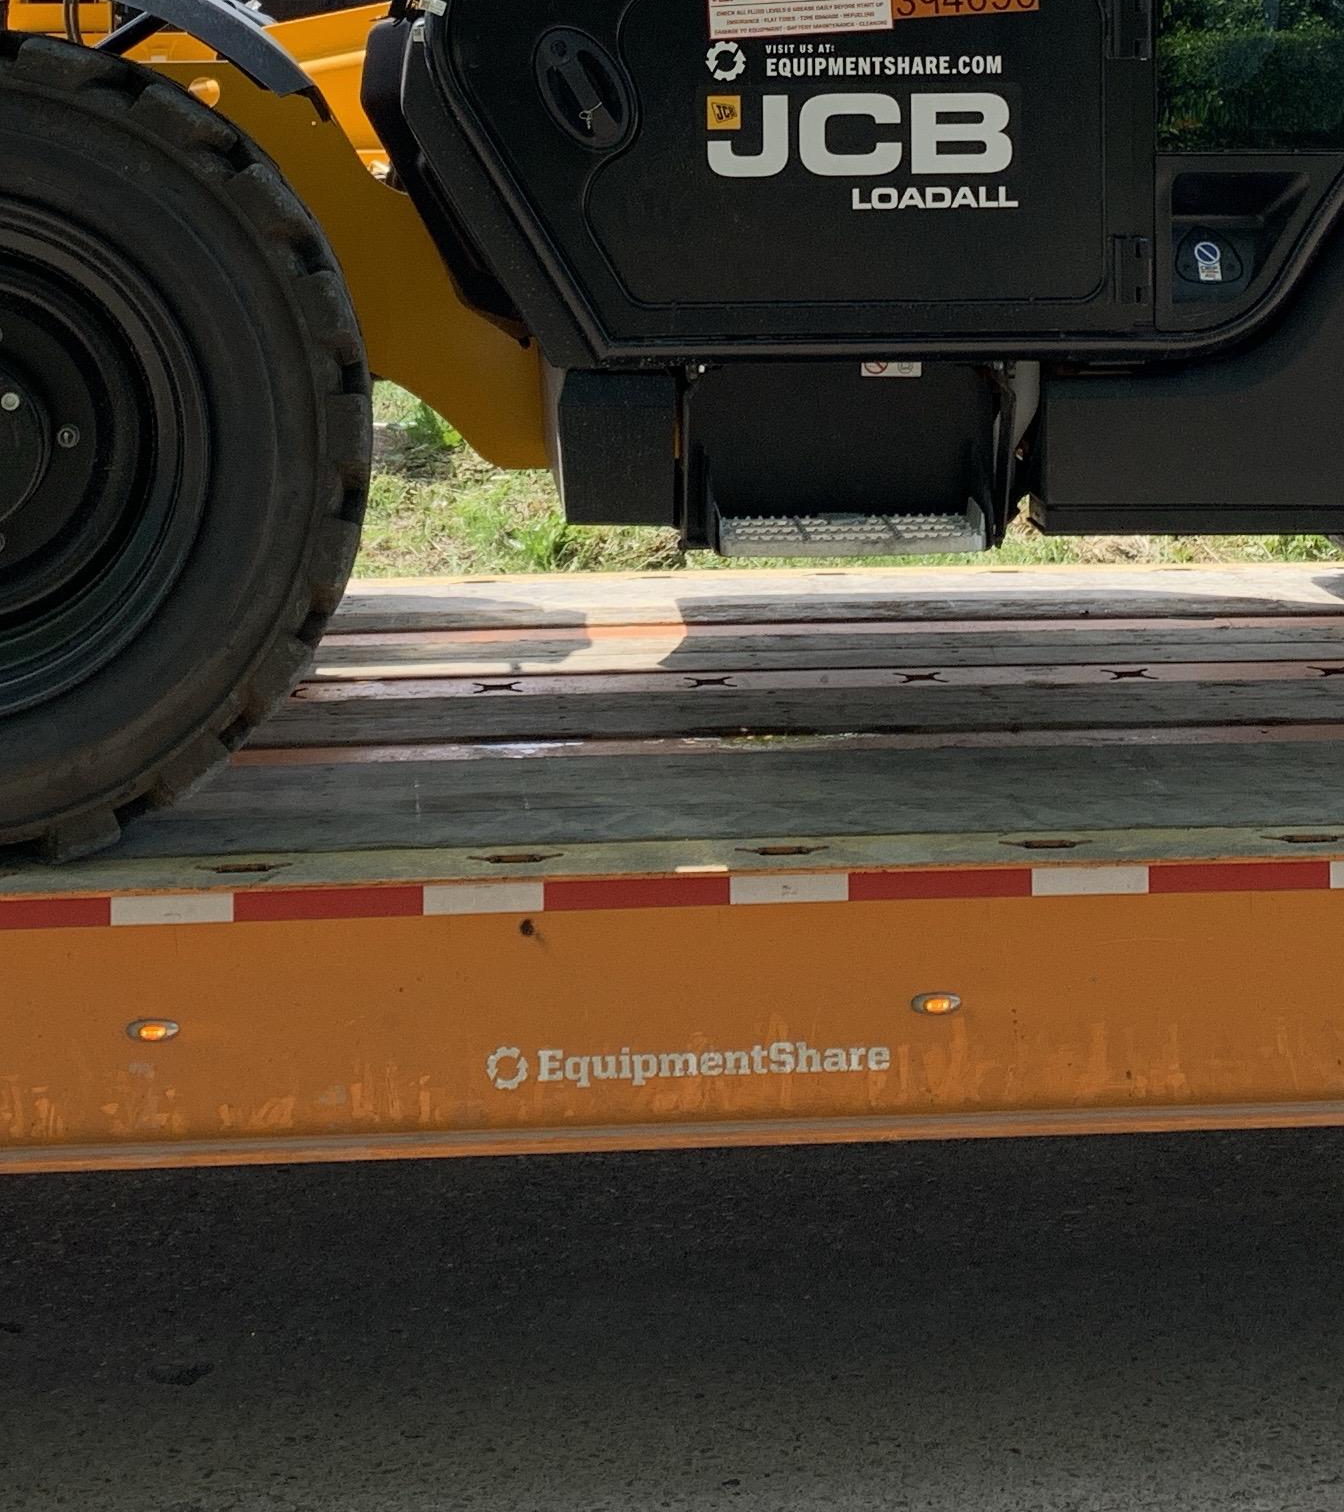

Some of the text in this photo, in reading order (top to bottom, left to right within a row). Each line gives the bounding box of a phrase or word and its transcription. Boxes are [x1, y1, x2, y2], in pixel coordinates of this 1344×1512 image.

[765, 44, 796, 54] VISIT
[800, 44, 815, 54] US
[766, 55, 1002, 79] EQUIPMENTSHARE.COM
[706, 93, 1013, 178] JCB
[851, 186, 1019, 210] LOADALL
[536, 1041, 891, 1088] EquipmentShare
